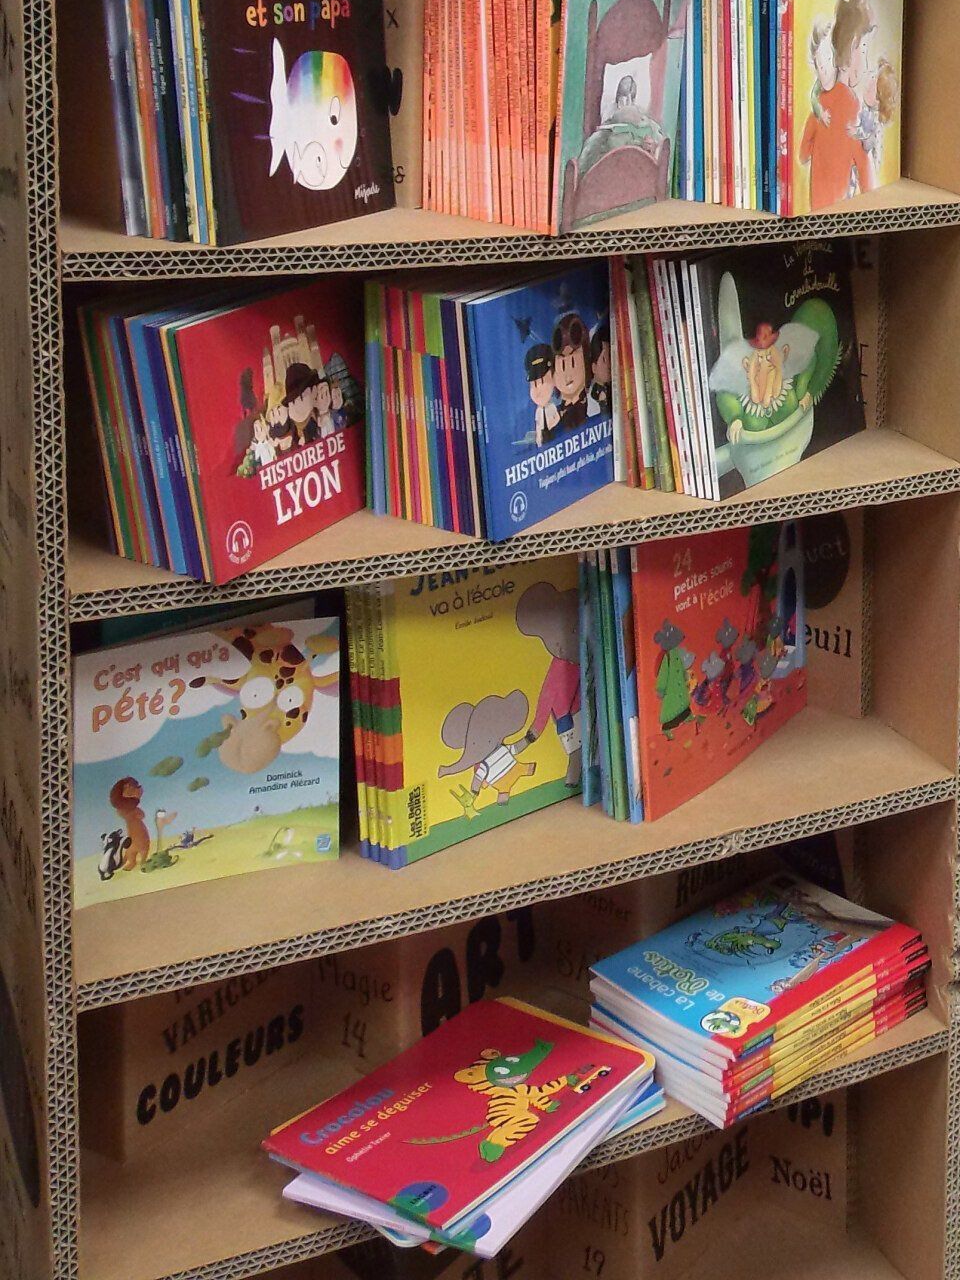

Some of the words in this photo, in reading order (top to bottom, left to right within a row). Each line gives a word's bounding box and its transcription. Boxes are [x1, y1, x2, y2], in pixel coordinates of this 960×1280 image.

[273, 1, 306, 25] son
[258, 440, 326, 491] HISTOIRE
[326, 431, 347, 463] DE
[504, 443, 565, 487] HISTOIRE
[564, 434, 580, 458] DE
[272, 458, 343, 527] LYON
[673, 548, 693, 578] 24
[674, 571, 708, 601] petites
[710, 556, 734, 578] souris
[429, 600, 449, 617] va
[452, 591, 464, 610] à
[466, 578, 516, 607] l'école
[675, 597, 692, 613] vont
[700, 579, 735, 611] l'école
[93, 660, 142, 693] C'est
[151, 650, 182, 678] qui
[187, 645, 231, 673] qu'a
[91, 677, 187, 734] pété?
[248, 782, 289, 795] Amandine
[265, 769, 304, 783] Dominick
[414, 783, 425, 840] HISTOIRES
[627, 965, 675, 999] cabane
[675, 995, 696, 1012] La
[135, 1003, 306, 1127] COULEURS
[324, 1129, 362, 1155] aime
[360, 1118, 379, 1132] se
[377, 1081, 433, 1121] déguiser
[647, 1125, 752, 1262] VOYAGE
[769, 1155, 833, 1202] Noël
